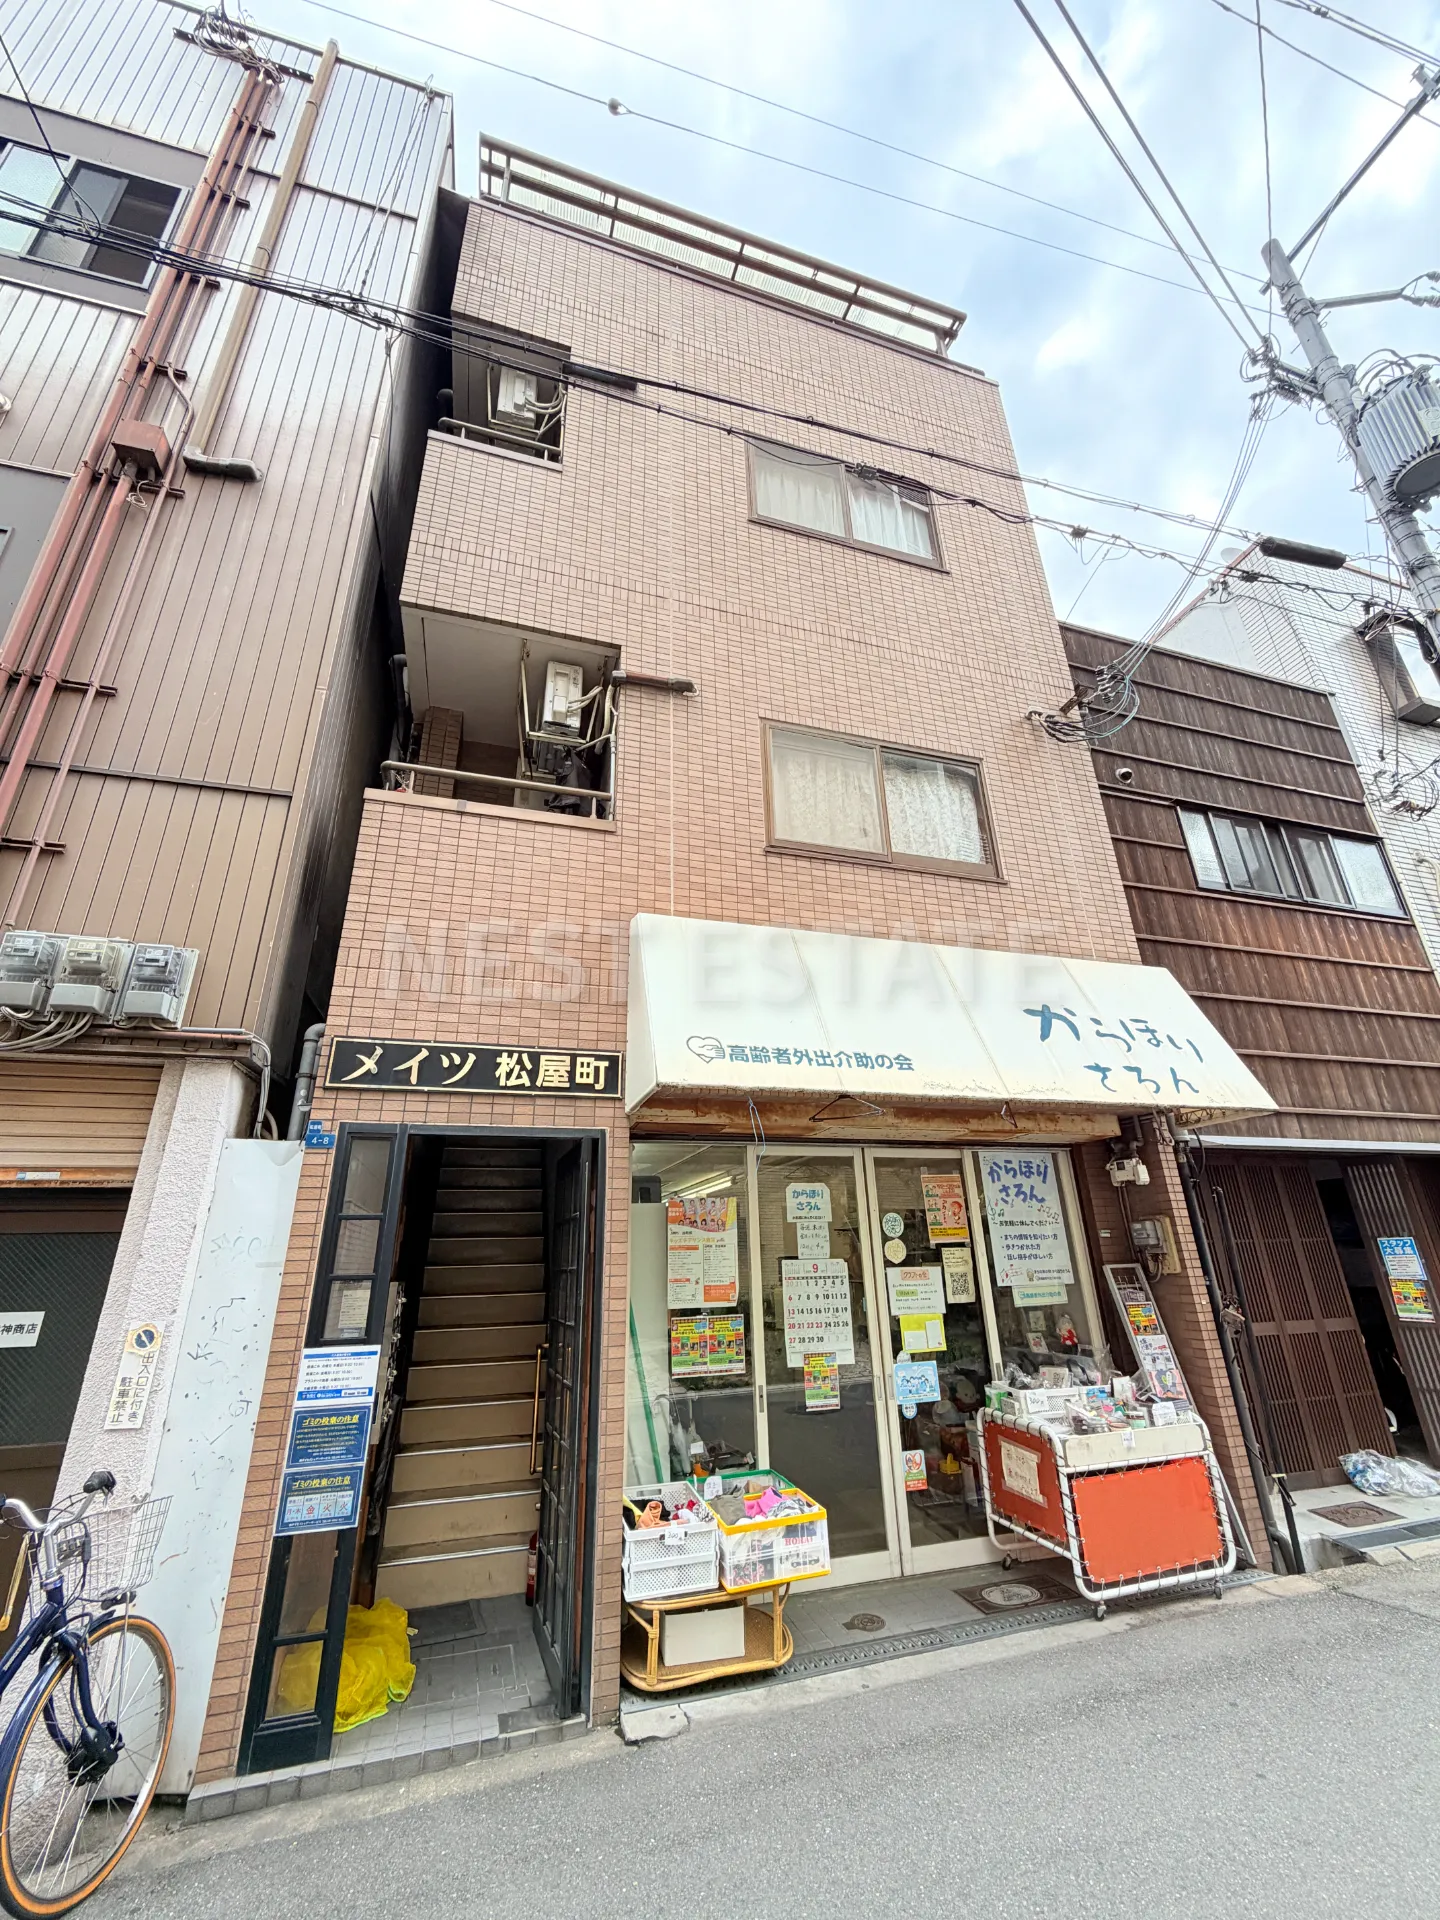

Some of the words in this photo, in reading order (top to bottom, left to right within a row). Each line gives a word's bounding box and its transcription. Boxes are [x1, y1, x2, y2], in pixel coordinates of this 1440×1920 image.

[1022, 1004, 1204, 1063] からほり
[726, 1044, 915, 1072] 高齢者外出介助の会
[341, 1045, 477, 1085] メイツ
[495, 1052, 609, 1090] 松屋町
[1083, 1062, 1200, 1094] さろん
[311, 1136, 330, 1145] 4-8
[988, 1159, 1049, 1185] からほり
[792, 1189, 824, 1199] からほり
[998, 1183, 1047, 1205] さろん
[796, 1201, 821, 1211] さろん
[812, 1263, 819, 1273] 9
[0, 1323, 38, 1335] 神商店
[787, 1322, 796, 1330] 20
[110, 1377, 133, 1424] 駐車禁止
[302, 1414, 359, 1426] ゴミの投棄の注意
[292, 1475, 351, 1489] ゴミの投棄の注意
[306, 1504, 315, 1514] 金
[323, 1503, 332, 1513] 火
[339, 1501, 348, 1512] 火
